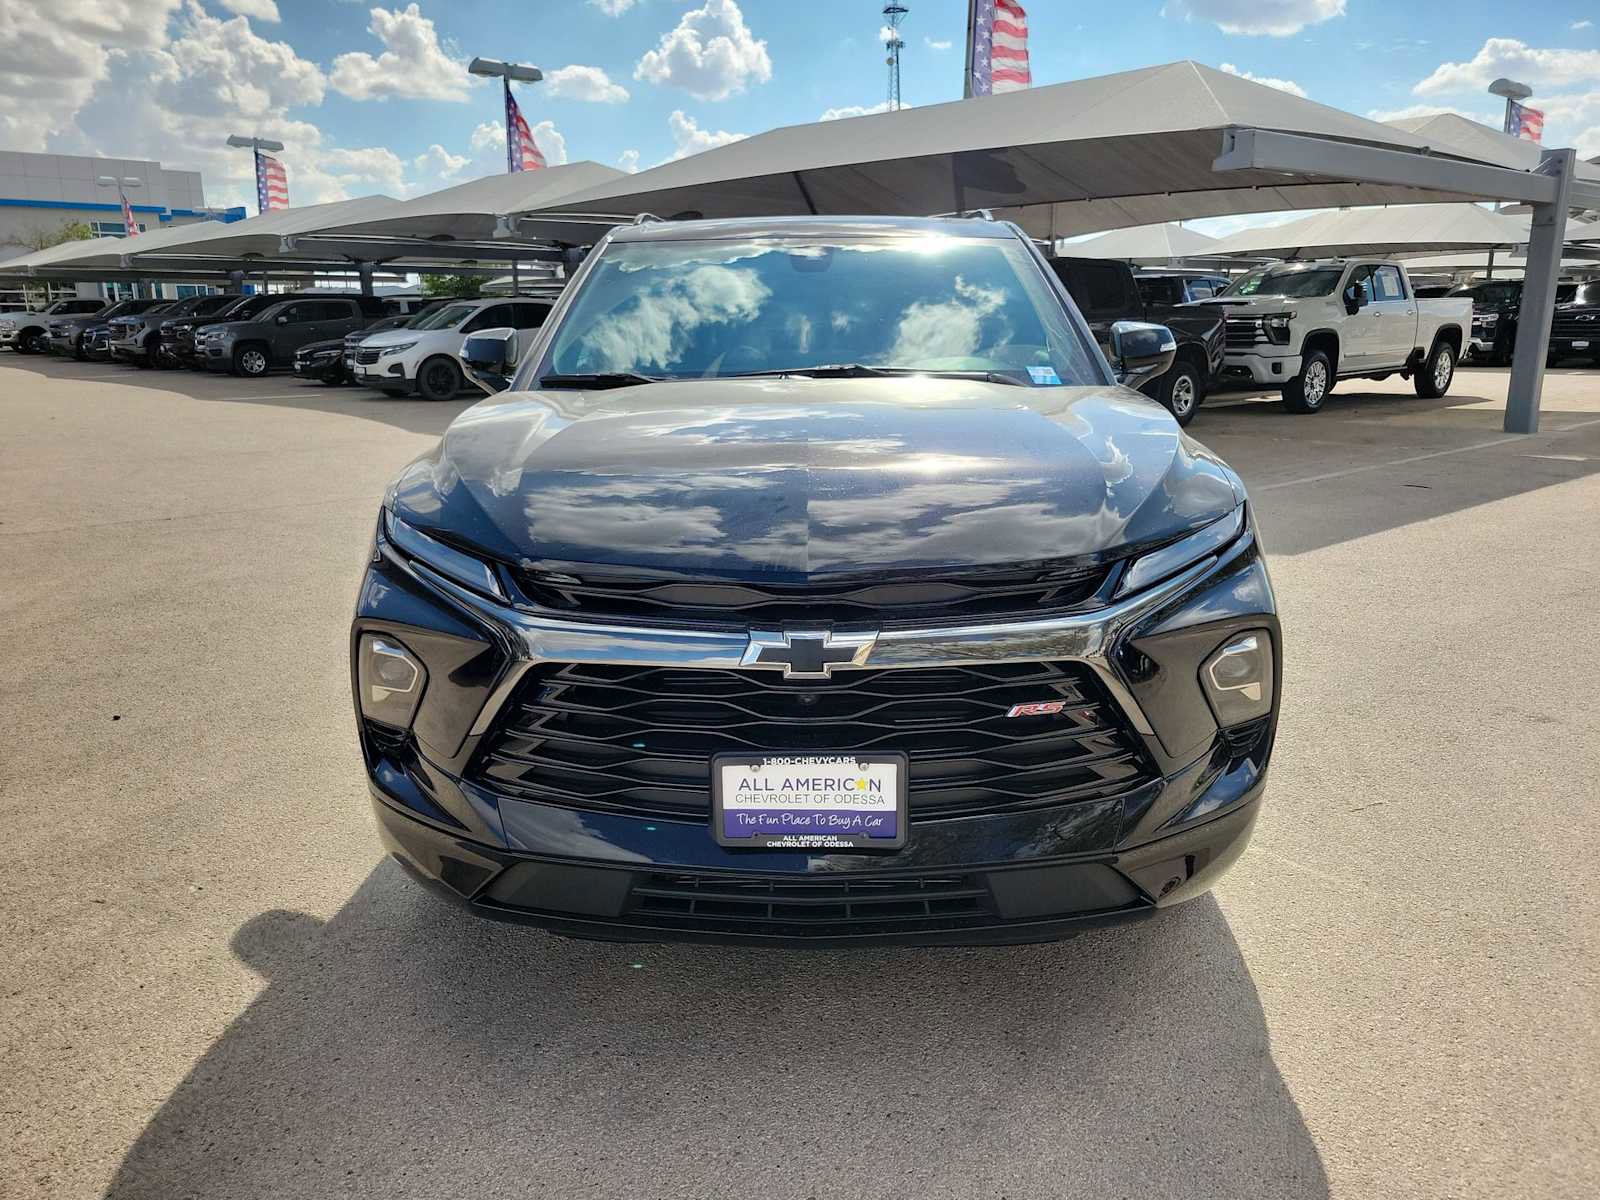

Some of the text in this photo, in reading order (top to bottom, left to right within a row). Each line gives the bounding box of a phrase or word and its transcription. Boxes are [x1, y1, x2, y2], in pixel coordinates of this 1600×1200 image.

[1007, 701, 1066, 717] RS
[762, 757, 856, 765] 1-800-CHEVYCARS
[738, 778, 775, 791] ALL
[735, 794, 885, 805] CHEVROLET OF ODESSA
[736, 813, 884, 829] The Fun Place To Buy A Car
